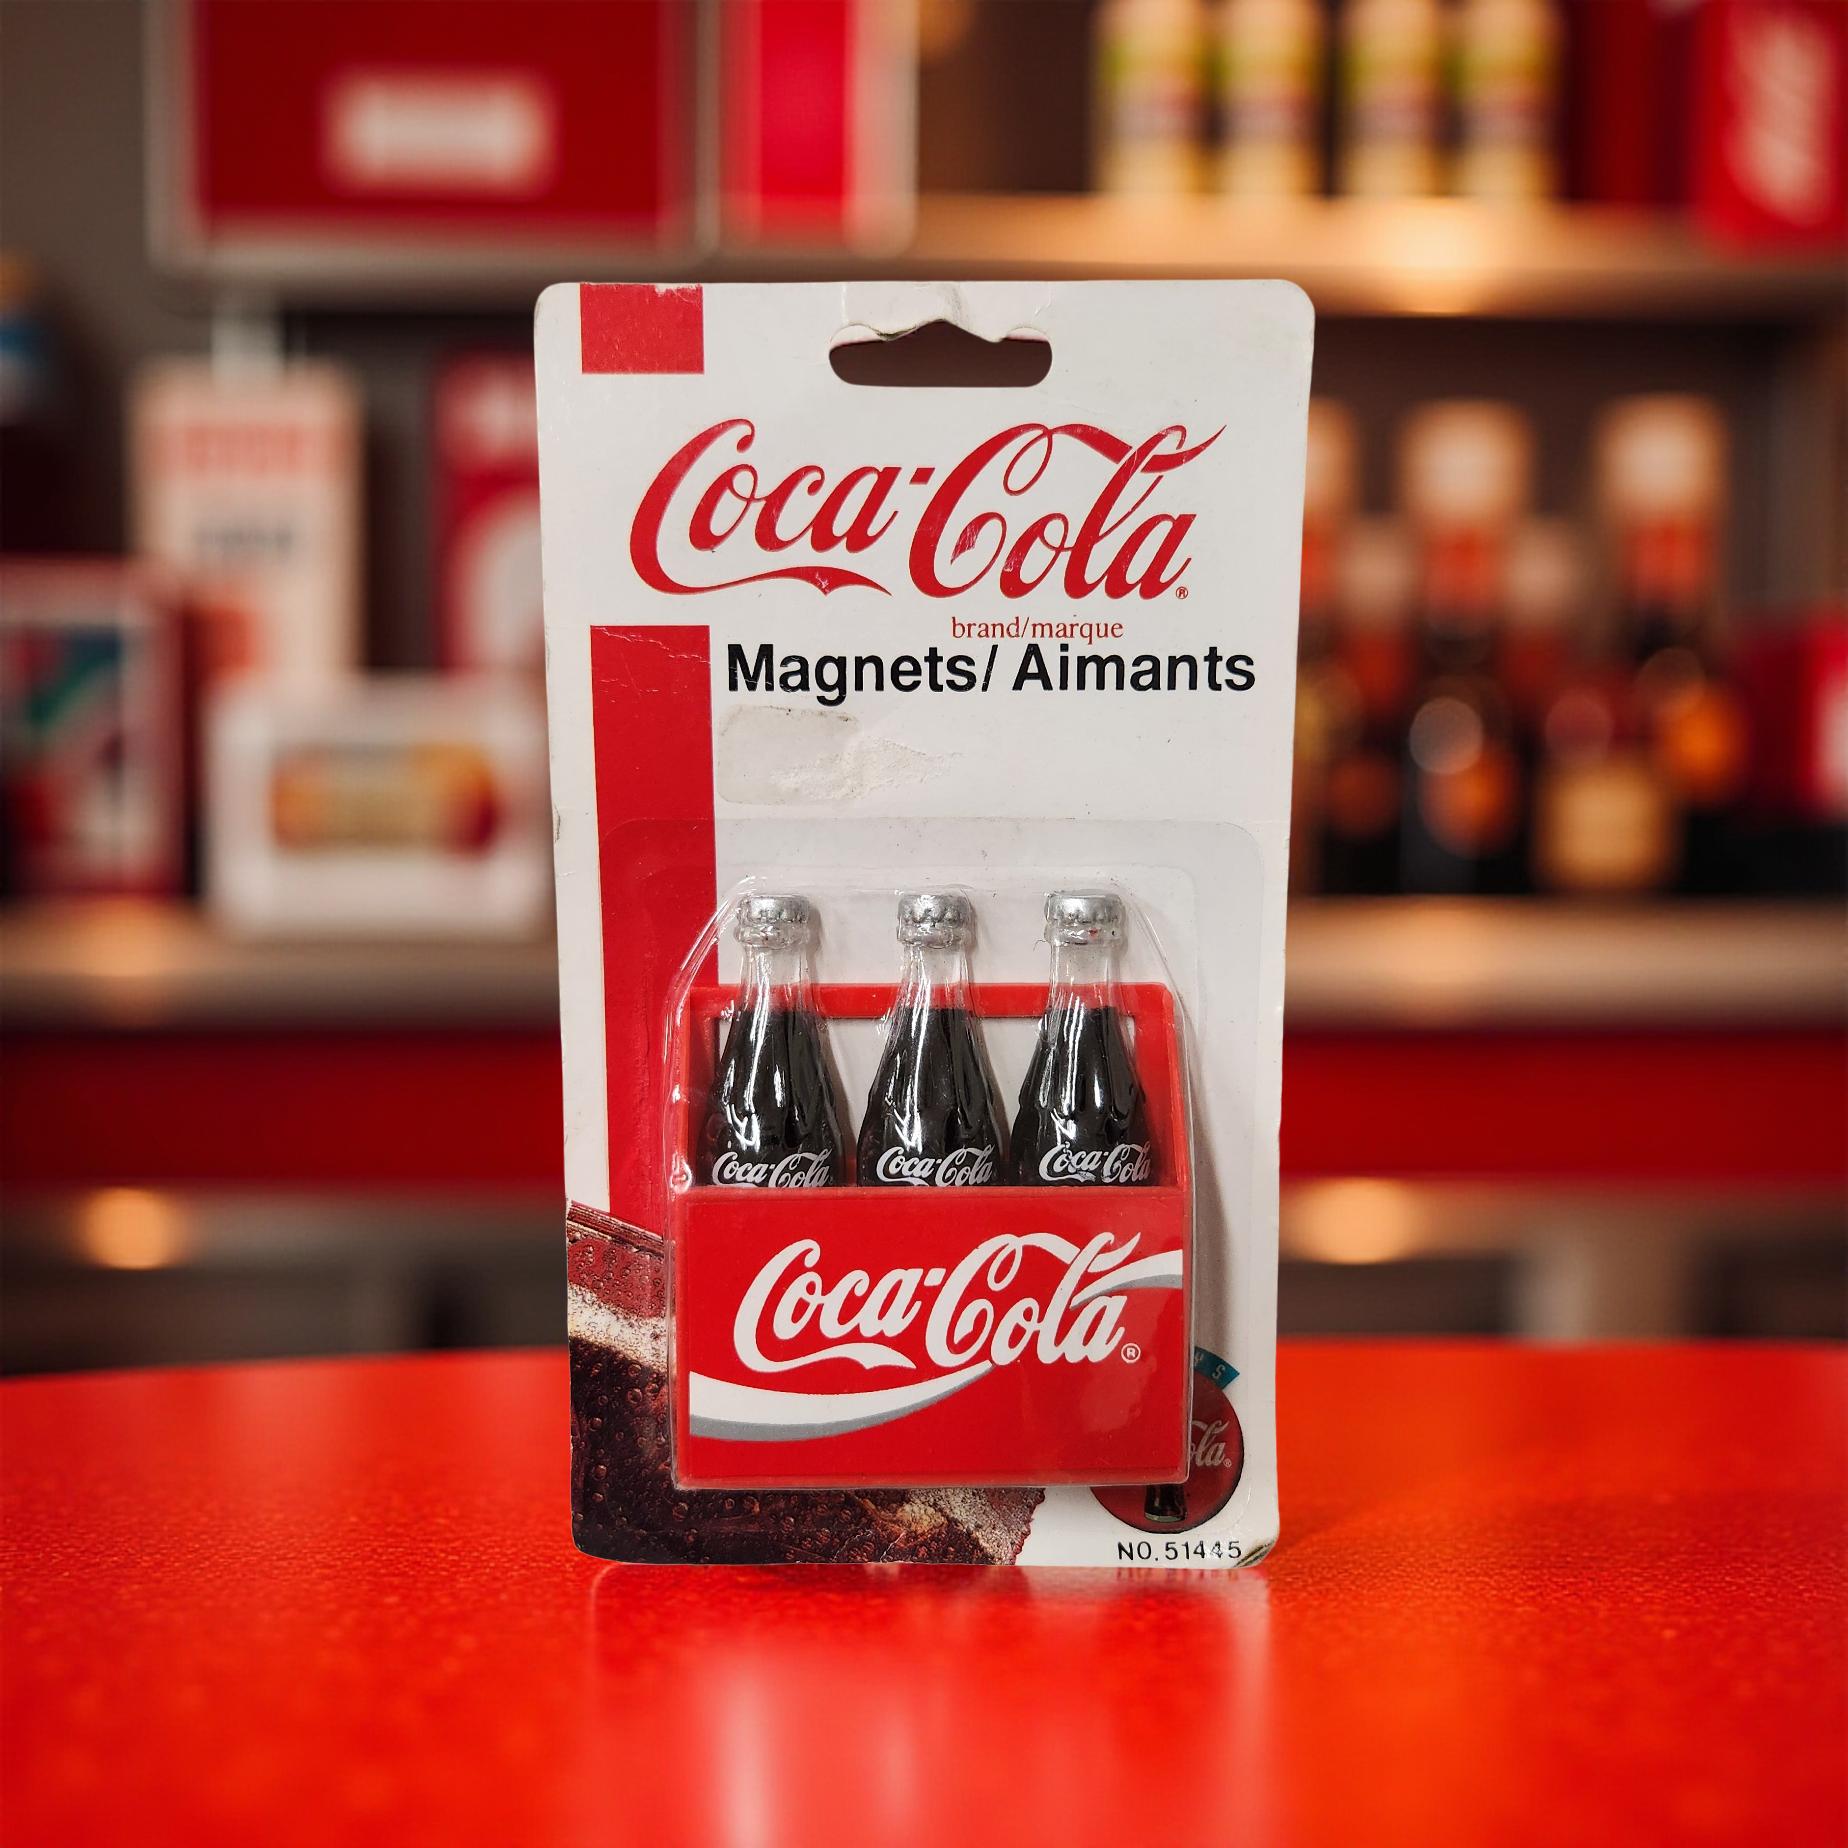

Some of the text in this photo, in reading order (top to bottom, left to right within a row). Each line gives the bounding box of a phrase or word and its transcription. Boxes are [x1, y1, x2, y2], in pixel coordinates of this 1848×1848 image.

[951, 616, 1124, 645] brand/marque
[727, 643, 1257, 706] Magnets/ Aimants
[711, 1148, 832, 1187] Coca-Cola
[876, 1144, 994, 1187] Coca-Cola
[1038, 1141, 1151, 1183] Coca-Cola
